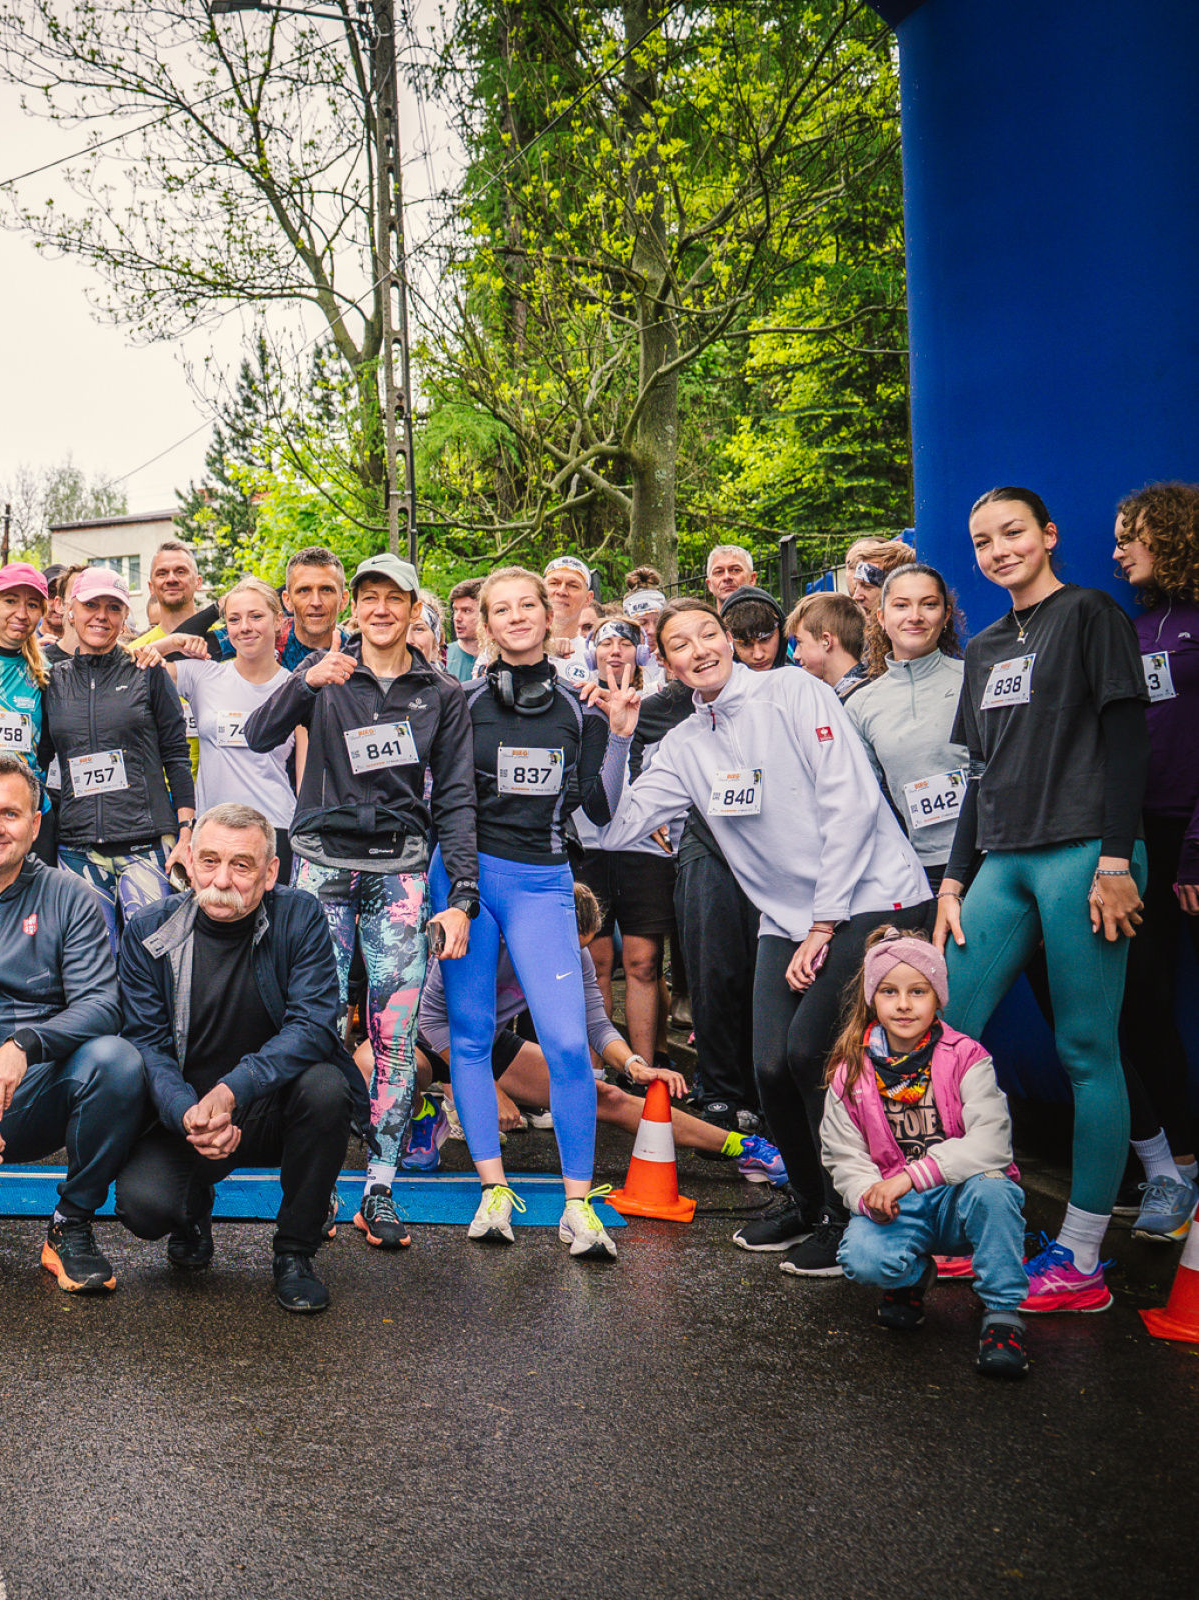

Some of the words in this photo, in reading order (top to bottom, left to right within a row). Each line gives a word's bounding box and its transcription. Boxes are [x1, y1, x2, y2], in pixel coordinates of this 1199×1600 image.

[993, 675, 1022, 696] 838
[366, 740, 402, 760] 841
[83, 767, 115, 786] 757
[513, 767, 552, 784] 837
[723, 788, 755, 806] 840
[920, 790, 959, 816] 842
